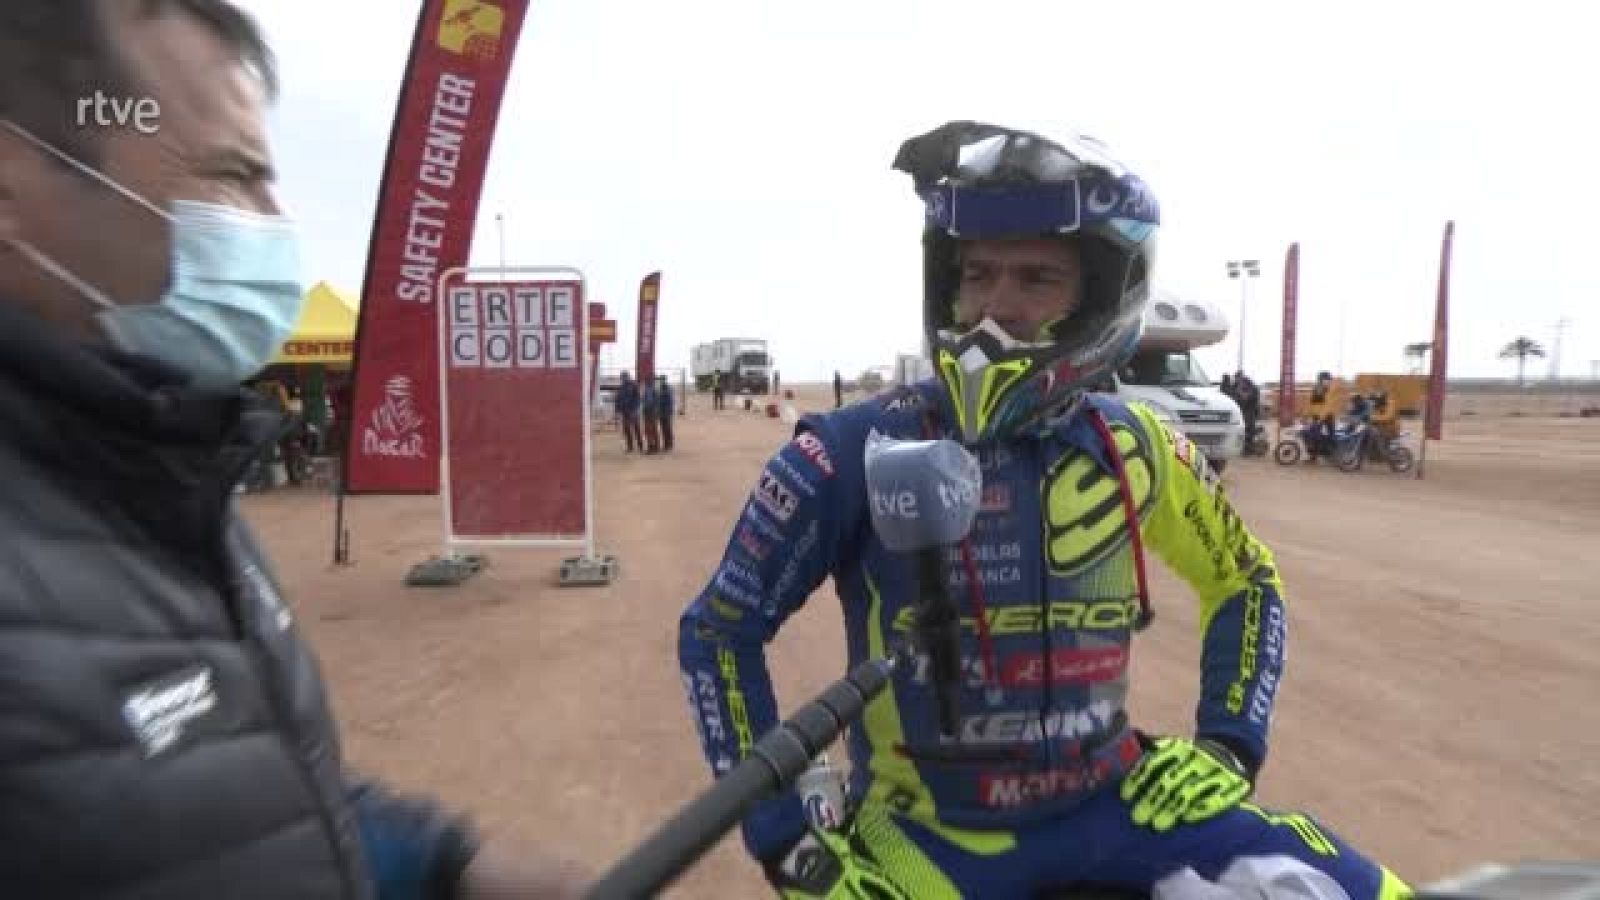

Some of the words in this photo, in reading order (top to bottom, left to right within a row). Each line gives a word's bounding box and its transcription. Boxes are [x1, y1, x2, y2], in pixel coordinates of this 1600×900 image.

[419, 73, 476, 189] CENTER
[396, 189, 449, 304] SAFETY
[454, 290, 569, 324] ERTF
[454, 332, 574, 362] CODE
[940, 701, 1111, 743] KENNY
